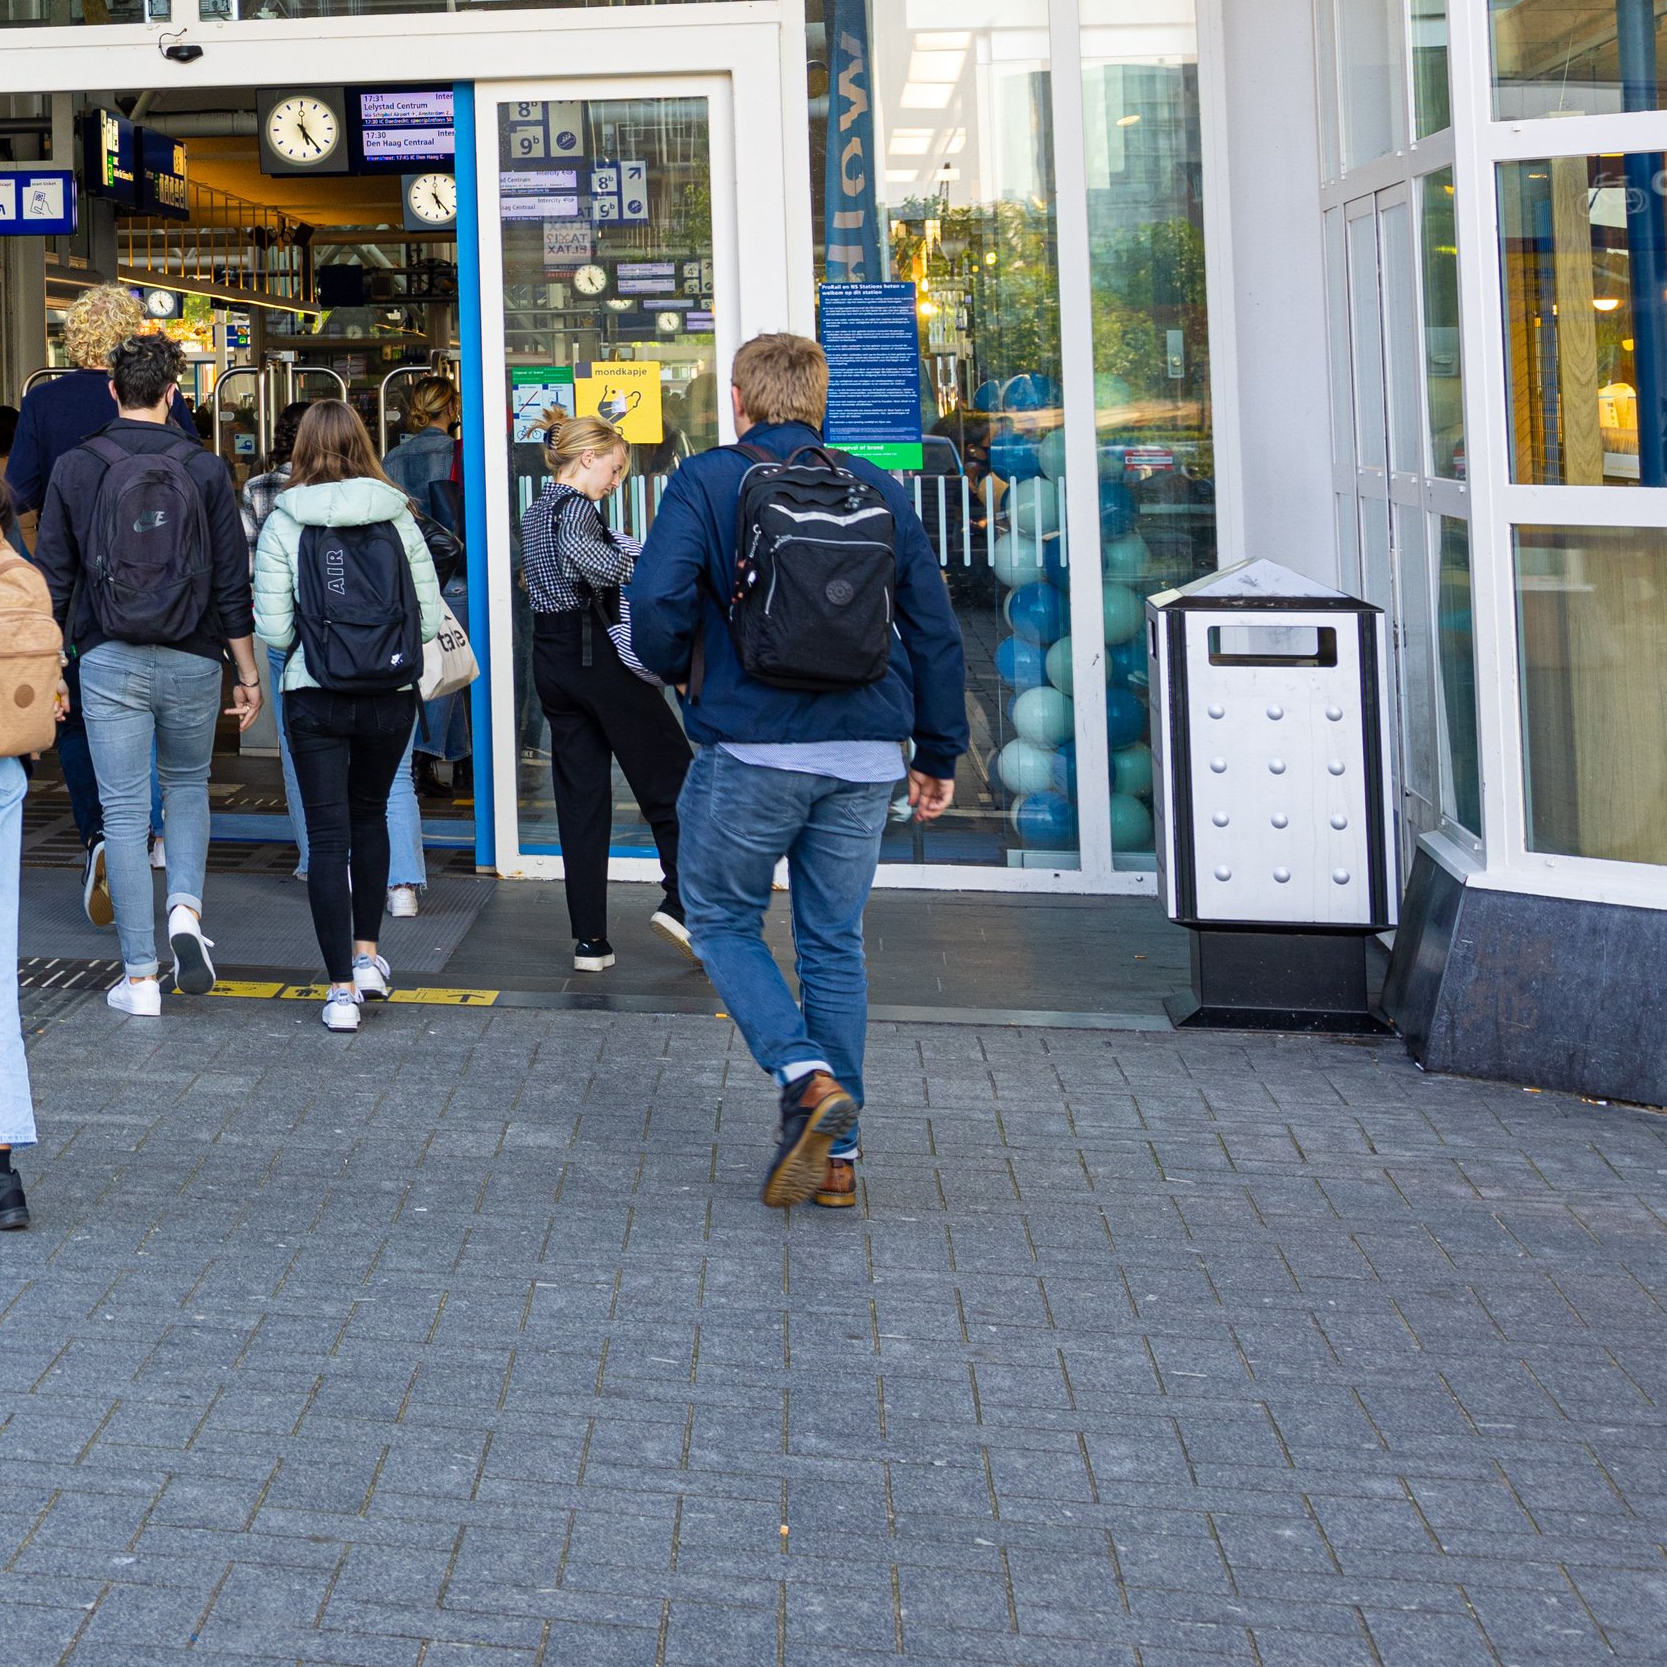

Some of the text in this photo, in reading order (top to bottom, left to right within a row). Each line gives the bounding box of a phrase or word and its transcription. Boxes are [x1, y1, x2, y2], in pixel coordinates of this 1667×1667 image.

[364, 103, 394, 111] Lelystad
[595, 367, 647, 376] mondkapje
[326, 550, 345, 595] AIR
